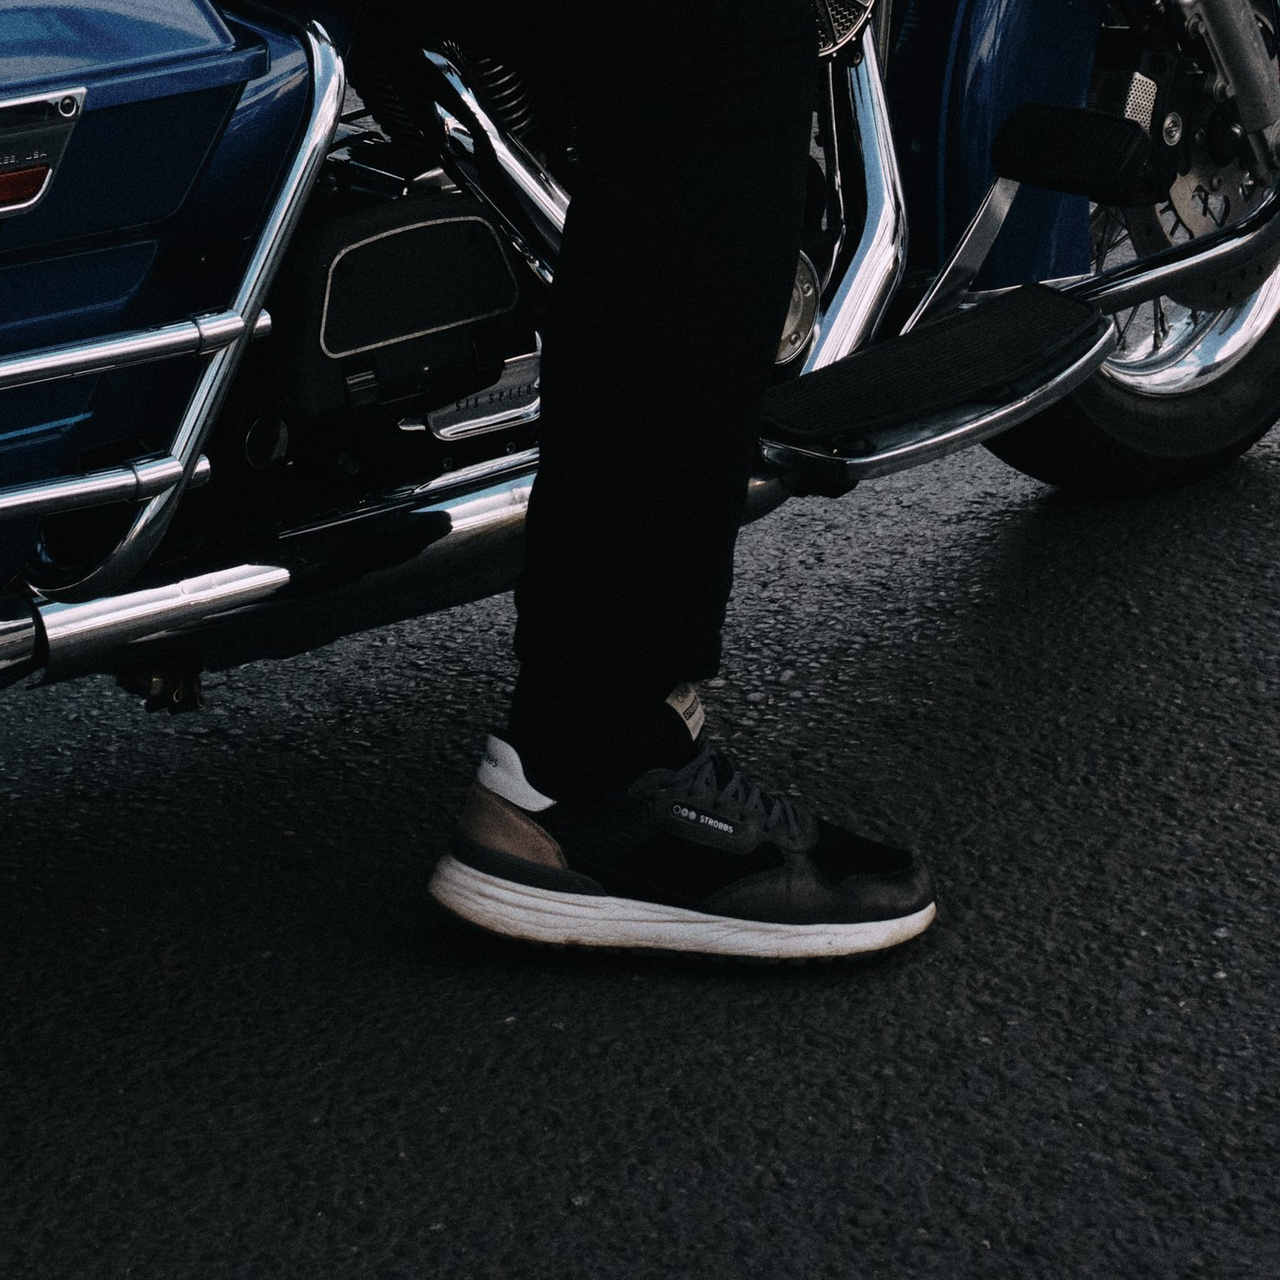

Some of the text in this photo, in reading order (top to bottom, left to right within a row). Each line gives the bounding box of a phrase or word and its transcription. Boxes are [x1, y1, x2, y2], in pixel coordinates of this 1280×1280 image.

[455, 384, 532, 412] SIX SPEED
[699, 814, 734, 835] STROBBS
